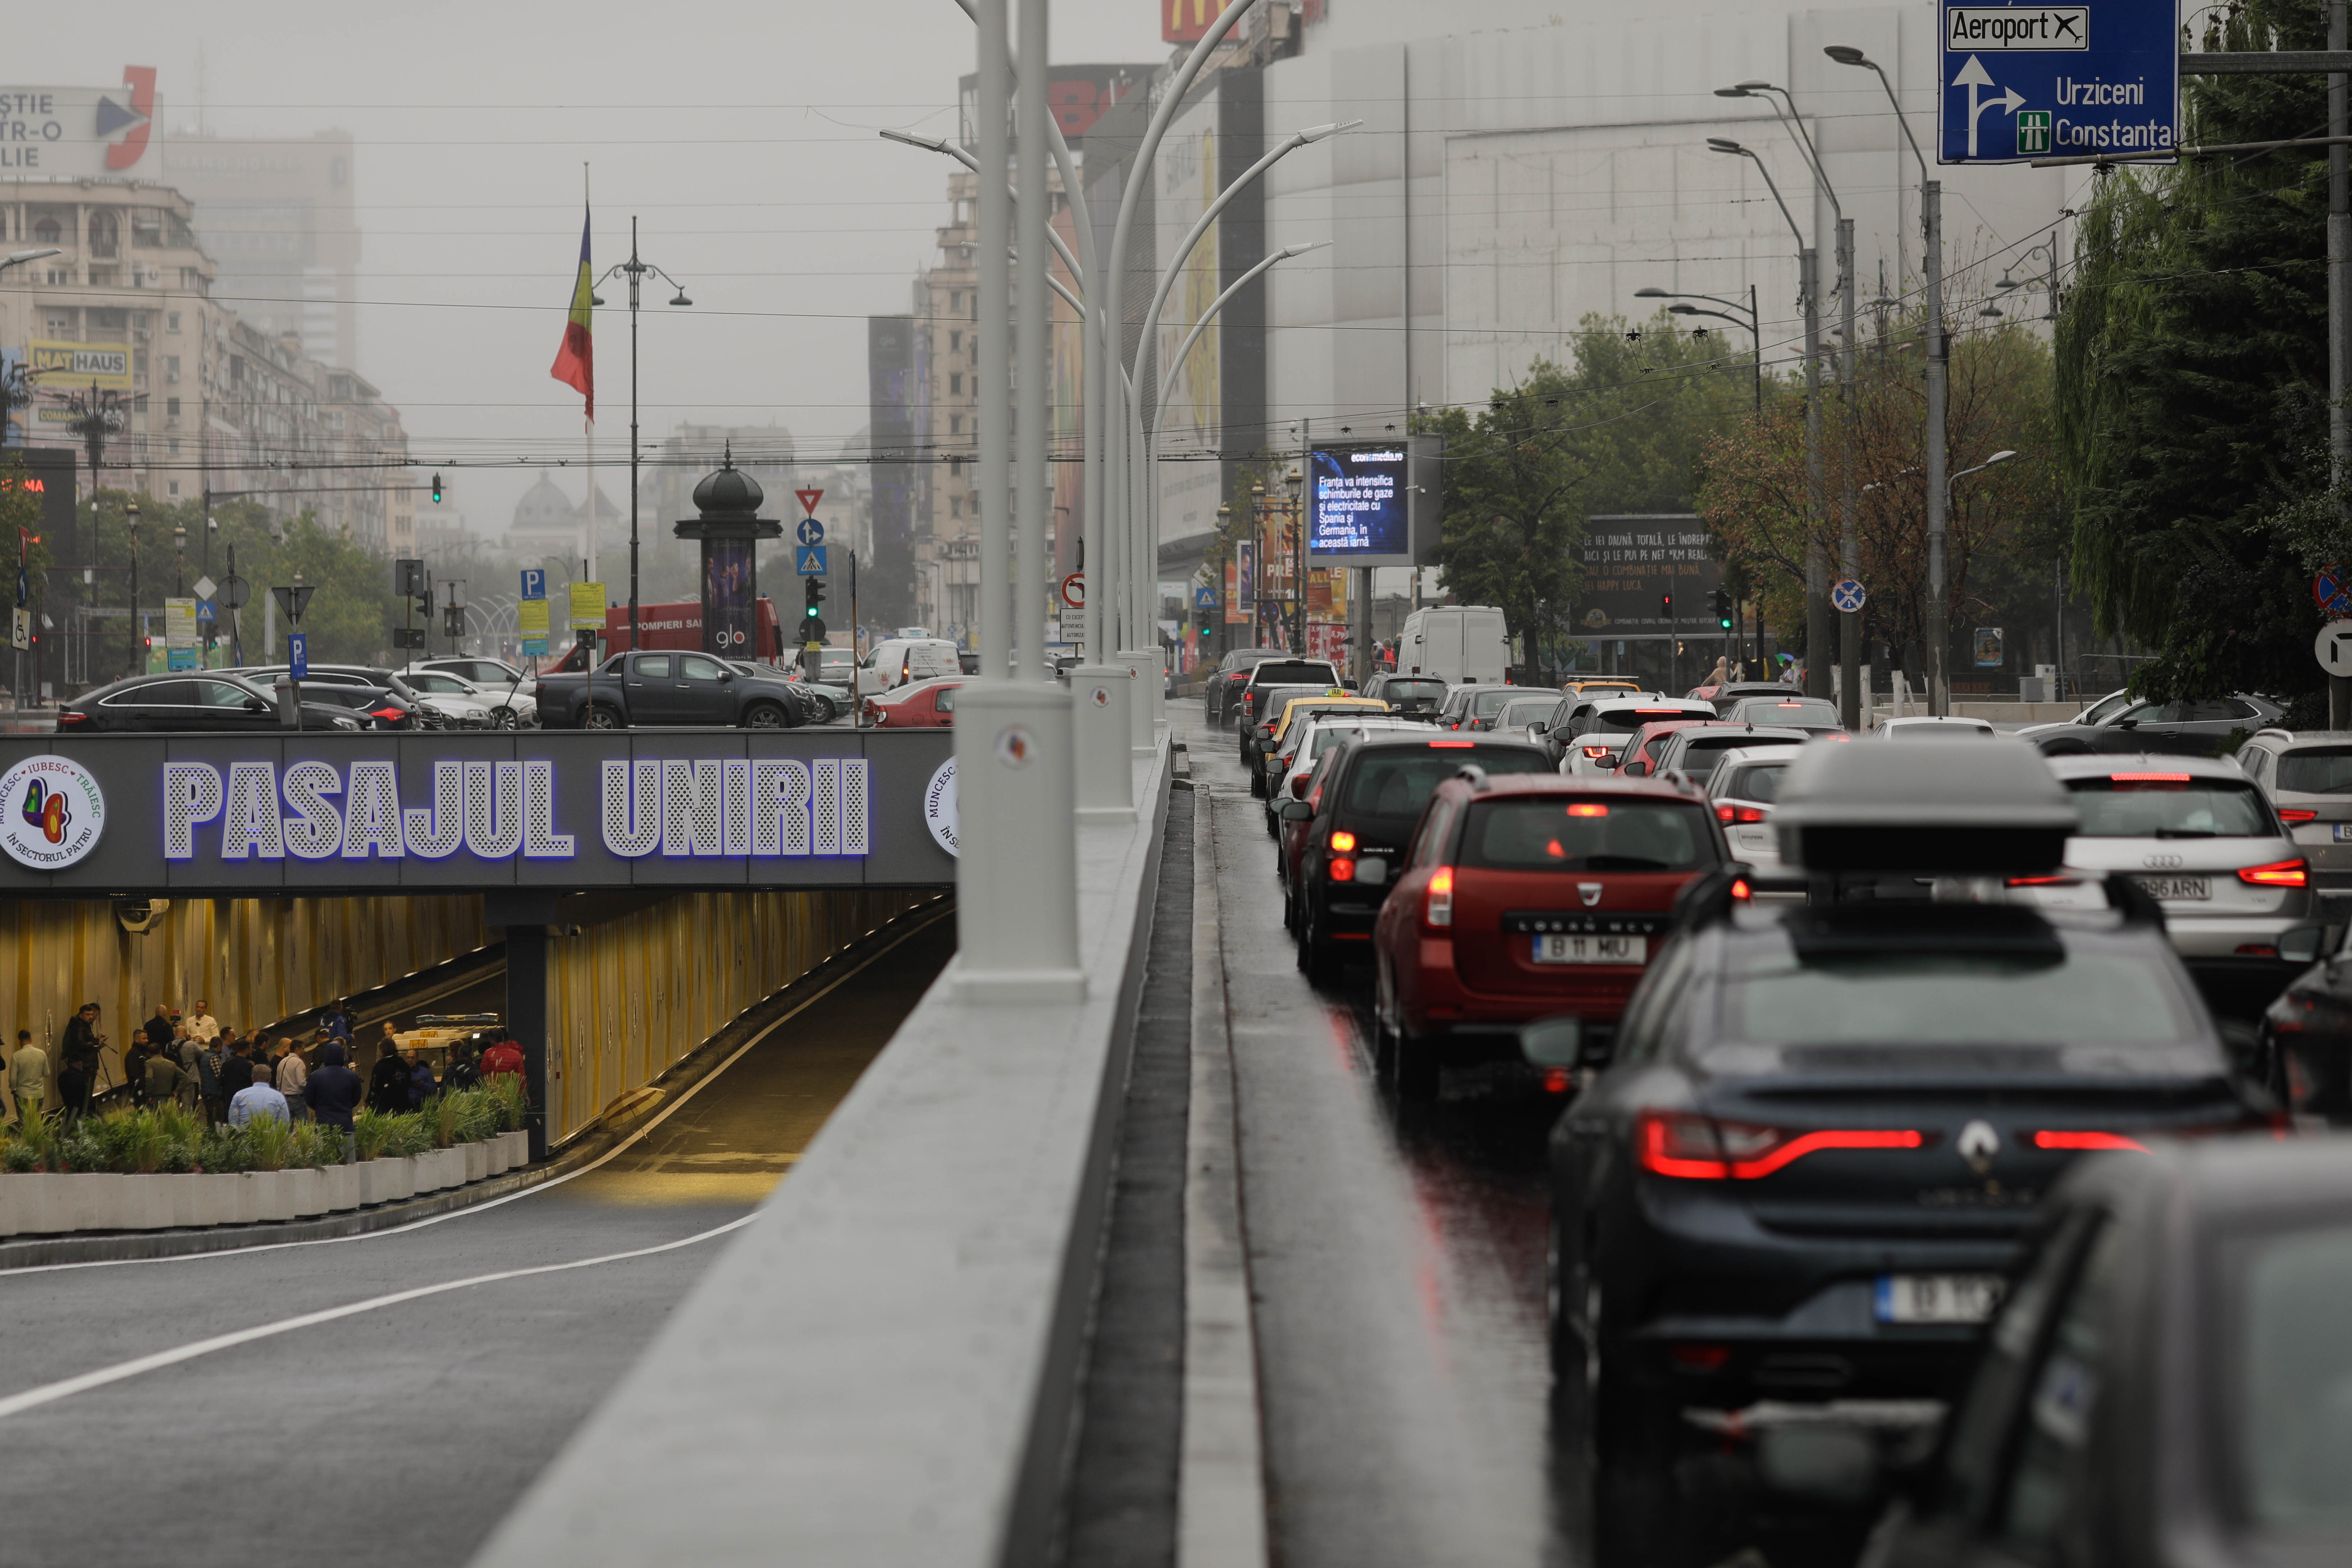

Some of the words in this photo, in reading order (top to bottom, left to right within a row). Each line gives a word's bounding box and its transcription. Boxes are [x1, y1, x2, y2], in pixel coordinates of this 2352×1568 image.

[1953, 12, 2048, 47] Aeroport
[2057, 77, 2144, 105] Urziceni
[2056, 119, 2171, 152] Constanța
[1351, 451, 1403, 462] economedia.ro
[1319, 476, 1343, 489] Franța
[1355, 475, 1393, 486] intensifica
[1319, 488, 1361, 499] schimburile
[1363, 488, 1373, 498] de
[1374, 489, 1393, 500] gaze
[1319, 500, 1325, 512] și
[1327, 500, 1369, 511] electricitate
[1371, 502, 1380, 510] cu
[1319, 512, 1345, 525] Spania
[1347, 513, 1353, 525] și
[1319, 525, 1358, 536] Germania,
[1360, 524, 1367, 534] în
[1319, 536, 1348, 548] această
[1350, 536, 1369, 547] iarnă
[1596, 536, 1604, 545] IEI
[1608, 532, 1633, 546] DAUNĂ
[1668, 535, 1676, 545] LE
[1584, 550, 1599, 561] AICI
[1603, 550, 1609, 563] ȘI
[1613, 550, 1621, 561] LE
[1624, 549, 1636, 561] PUI
[1640, 550, 1648, 561] PE
[1652, 549, 1666, 561] NET
[1603, 565, 1609, 575] O
[1612, 564, 1657, 577] COMBINAȚIE
[1661, 564, 1675, 575] MAI
[1584, 580, 1594, 591] IEI
[1597, 580, 1619, 590] HAPPY
[716, 623, 745, 649] glo
[1330, 645, 1345, 653] 6,99
[28, 762, 69, 774] IUBESC
[76, 773, 101, 818] TRĂIESC
[930, 766, 956, 818] MUNCESC
[163, 760, 575, 859] PASAJUL
[602, 758, 868, 856] UNIRII
[940, 825, 953, 840] ÎN
[6, 832, 19, 847] ÎN
[15, 844, 67, 862] SECTORUL
[68, 827, 92, 856] PATRU
[2172, 880, 2206, 897] ARN
[1518, 920, 1596, 932] LOGAN
[1551, 938, 1565, 957] B
[1574, 939, 1586, 956] 11
